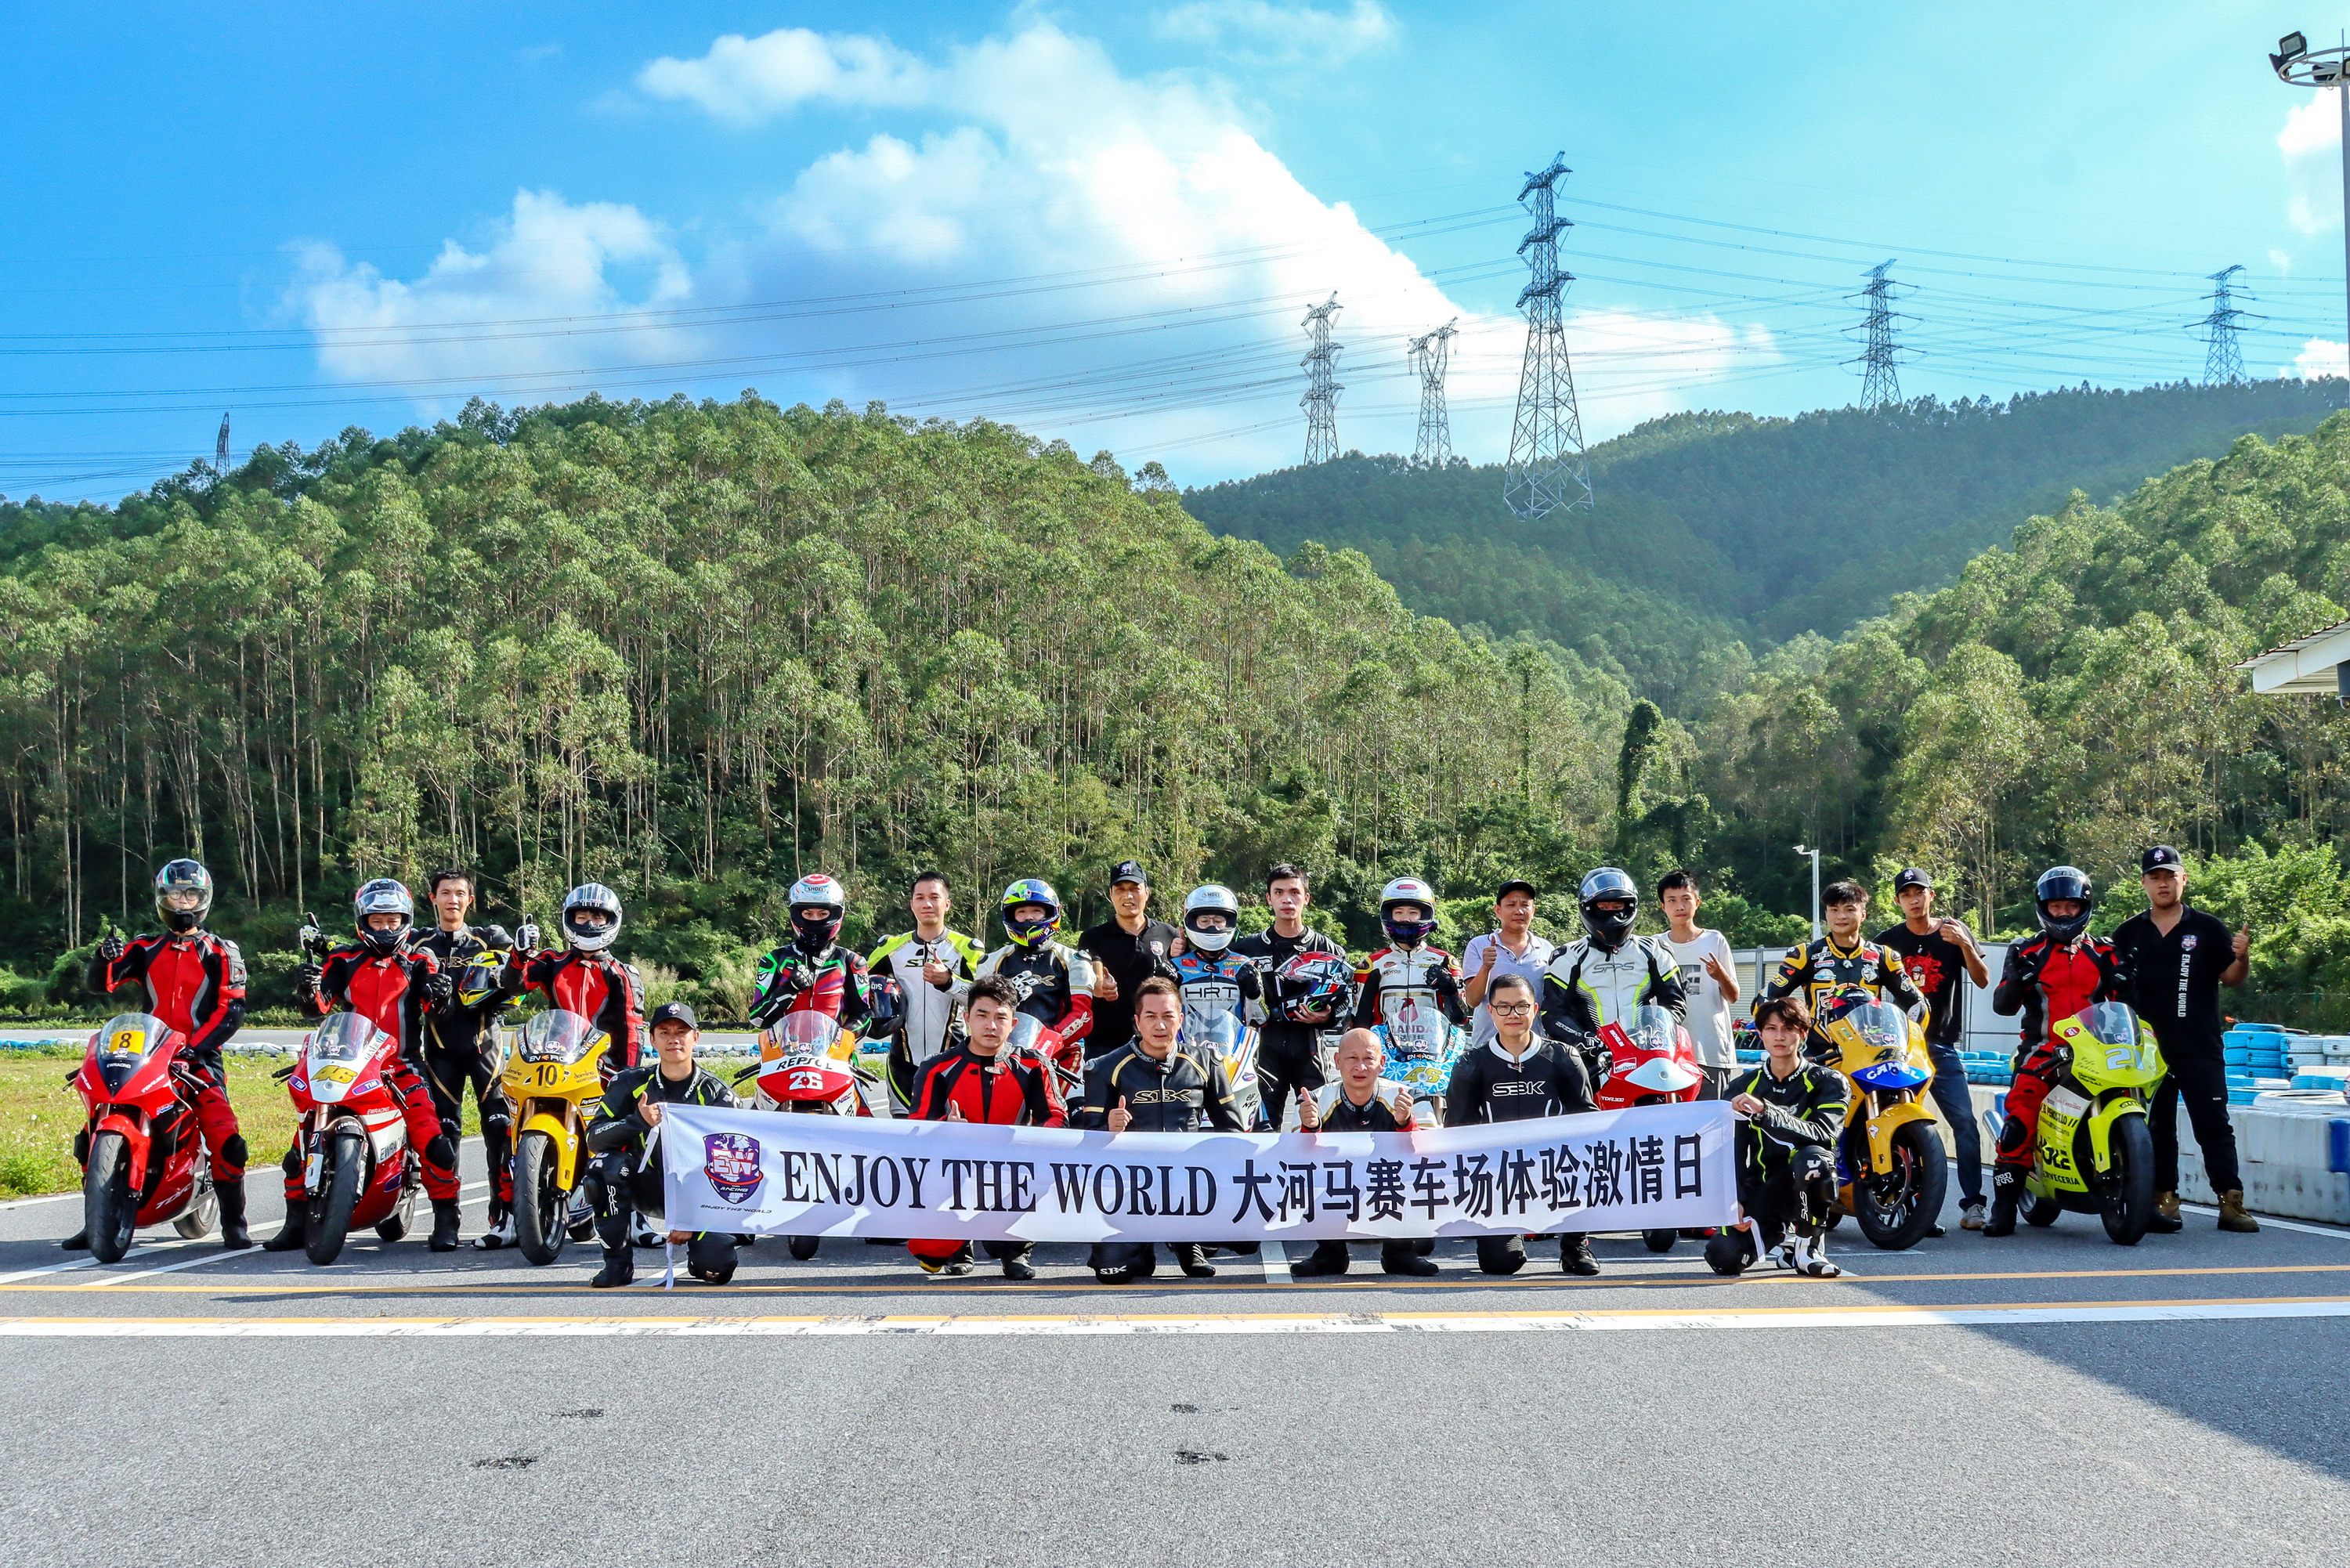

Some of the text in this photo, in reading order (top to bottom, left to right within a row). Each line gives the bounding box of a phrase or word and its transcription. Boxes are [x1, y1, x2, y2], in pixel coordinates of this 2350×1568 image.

[1184, 986, 1238, 999] HRT
[2177, 953, 2191, 1017] ENJOY THE WORLD
[119, 1032, 132, 1049] 8
[776, 1057, 833, 1071] REPSOL
[1866, 1062, 1921, 1080] CAMEL
[309, 1064, 358, 1084] 46
[536, 1064, 558, 1087] 10
[789, 1071, 823, 1091] 26
[1401, 1066, 1443, 1083] 46
[364, 1080, 379, 1090] TIM
[1492, 1080, 1546, 1097] SBK
[1132, 1089, 1191, 1104] SBK
[367, 1106, 390, 1116] EWRACING
[779, 1151, 1218, 1216] ENJOY THE WORLD
[1231, 1133, 1702, 1224] 大河马赛车场体验激情日
[1100, 1265, 1127, 1275] SBK
